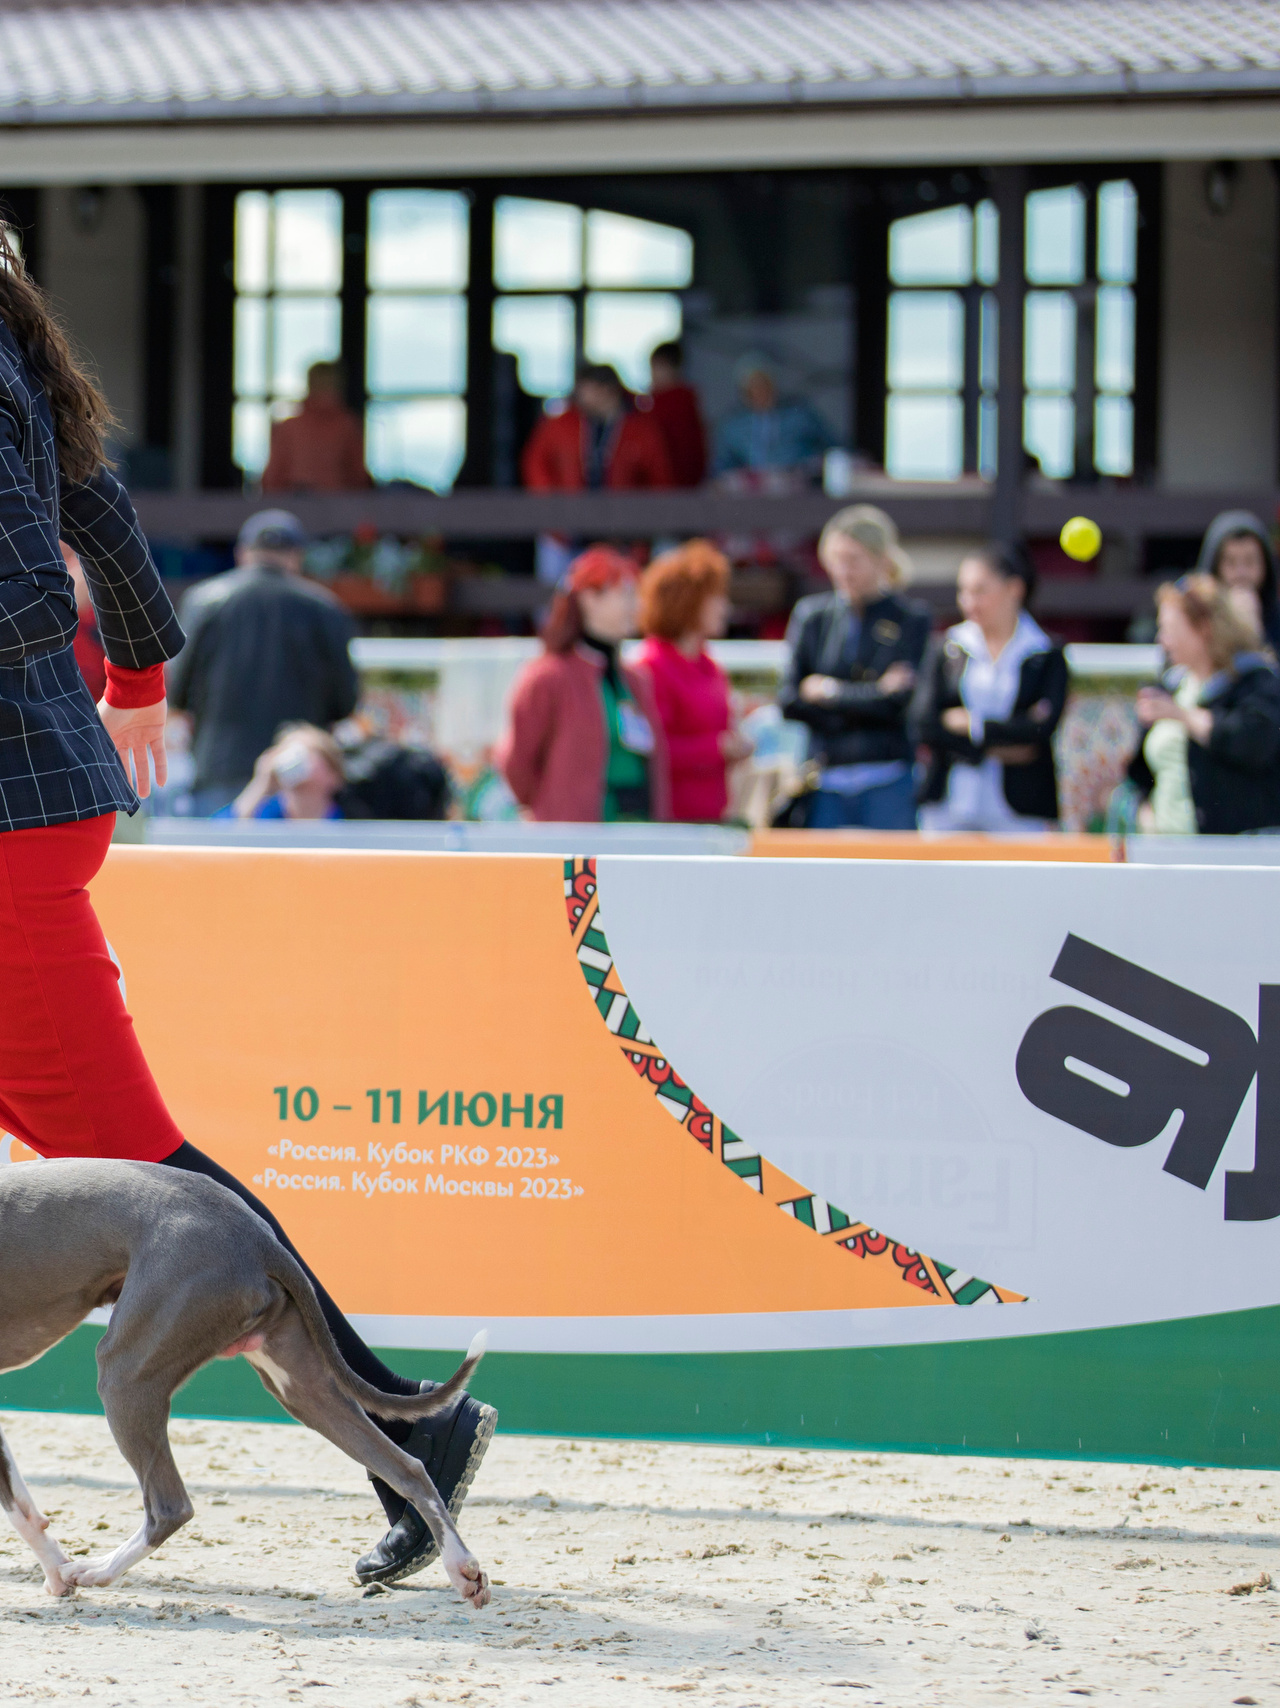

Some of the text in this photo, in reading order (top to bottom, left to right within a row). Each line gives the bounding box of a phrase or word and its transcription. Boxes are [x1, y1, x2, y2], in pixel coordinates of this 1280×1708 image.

[273, 1085, 320, 1122] 10
[365, 1088, 402, 1124] 11
[417, 1090, 565, 1130] ИЮНЯ
[267, 1139, 560, 1169] «Россия. Кубок РКФ 2023»
[252, 1168, 585, 1200] «Россия. Кубок Москвы 2023»
